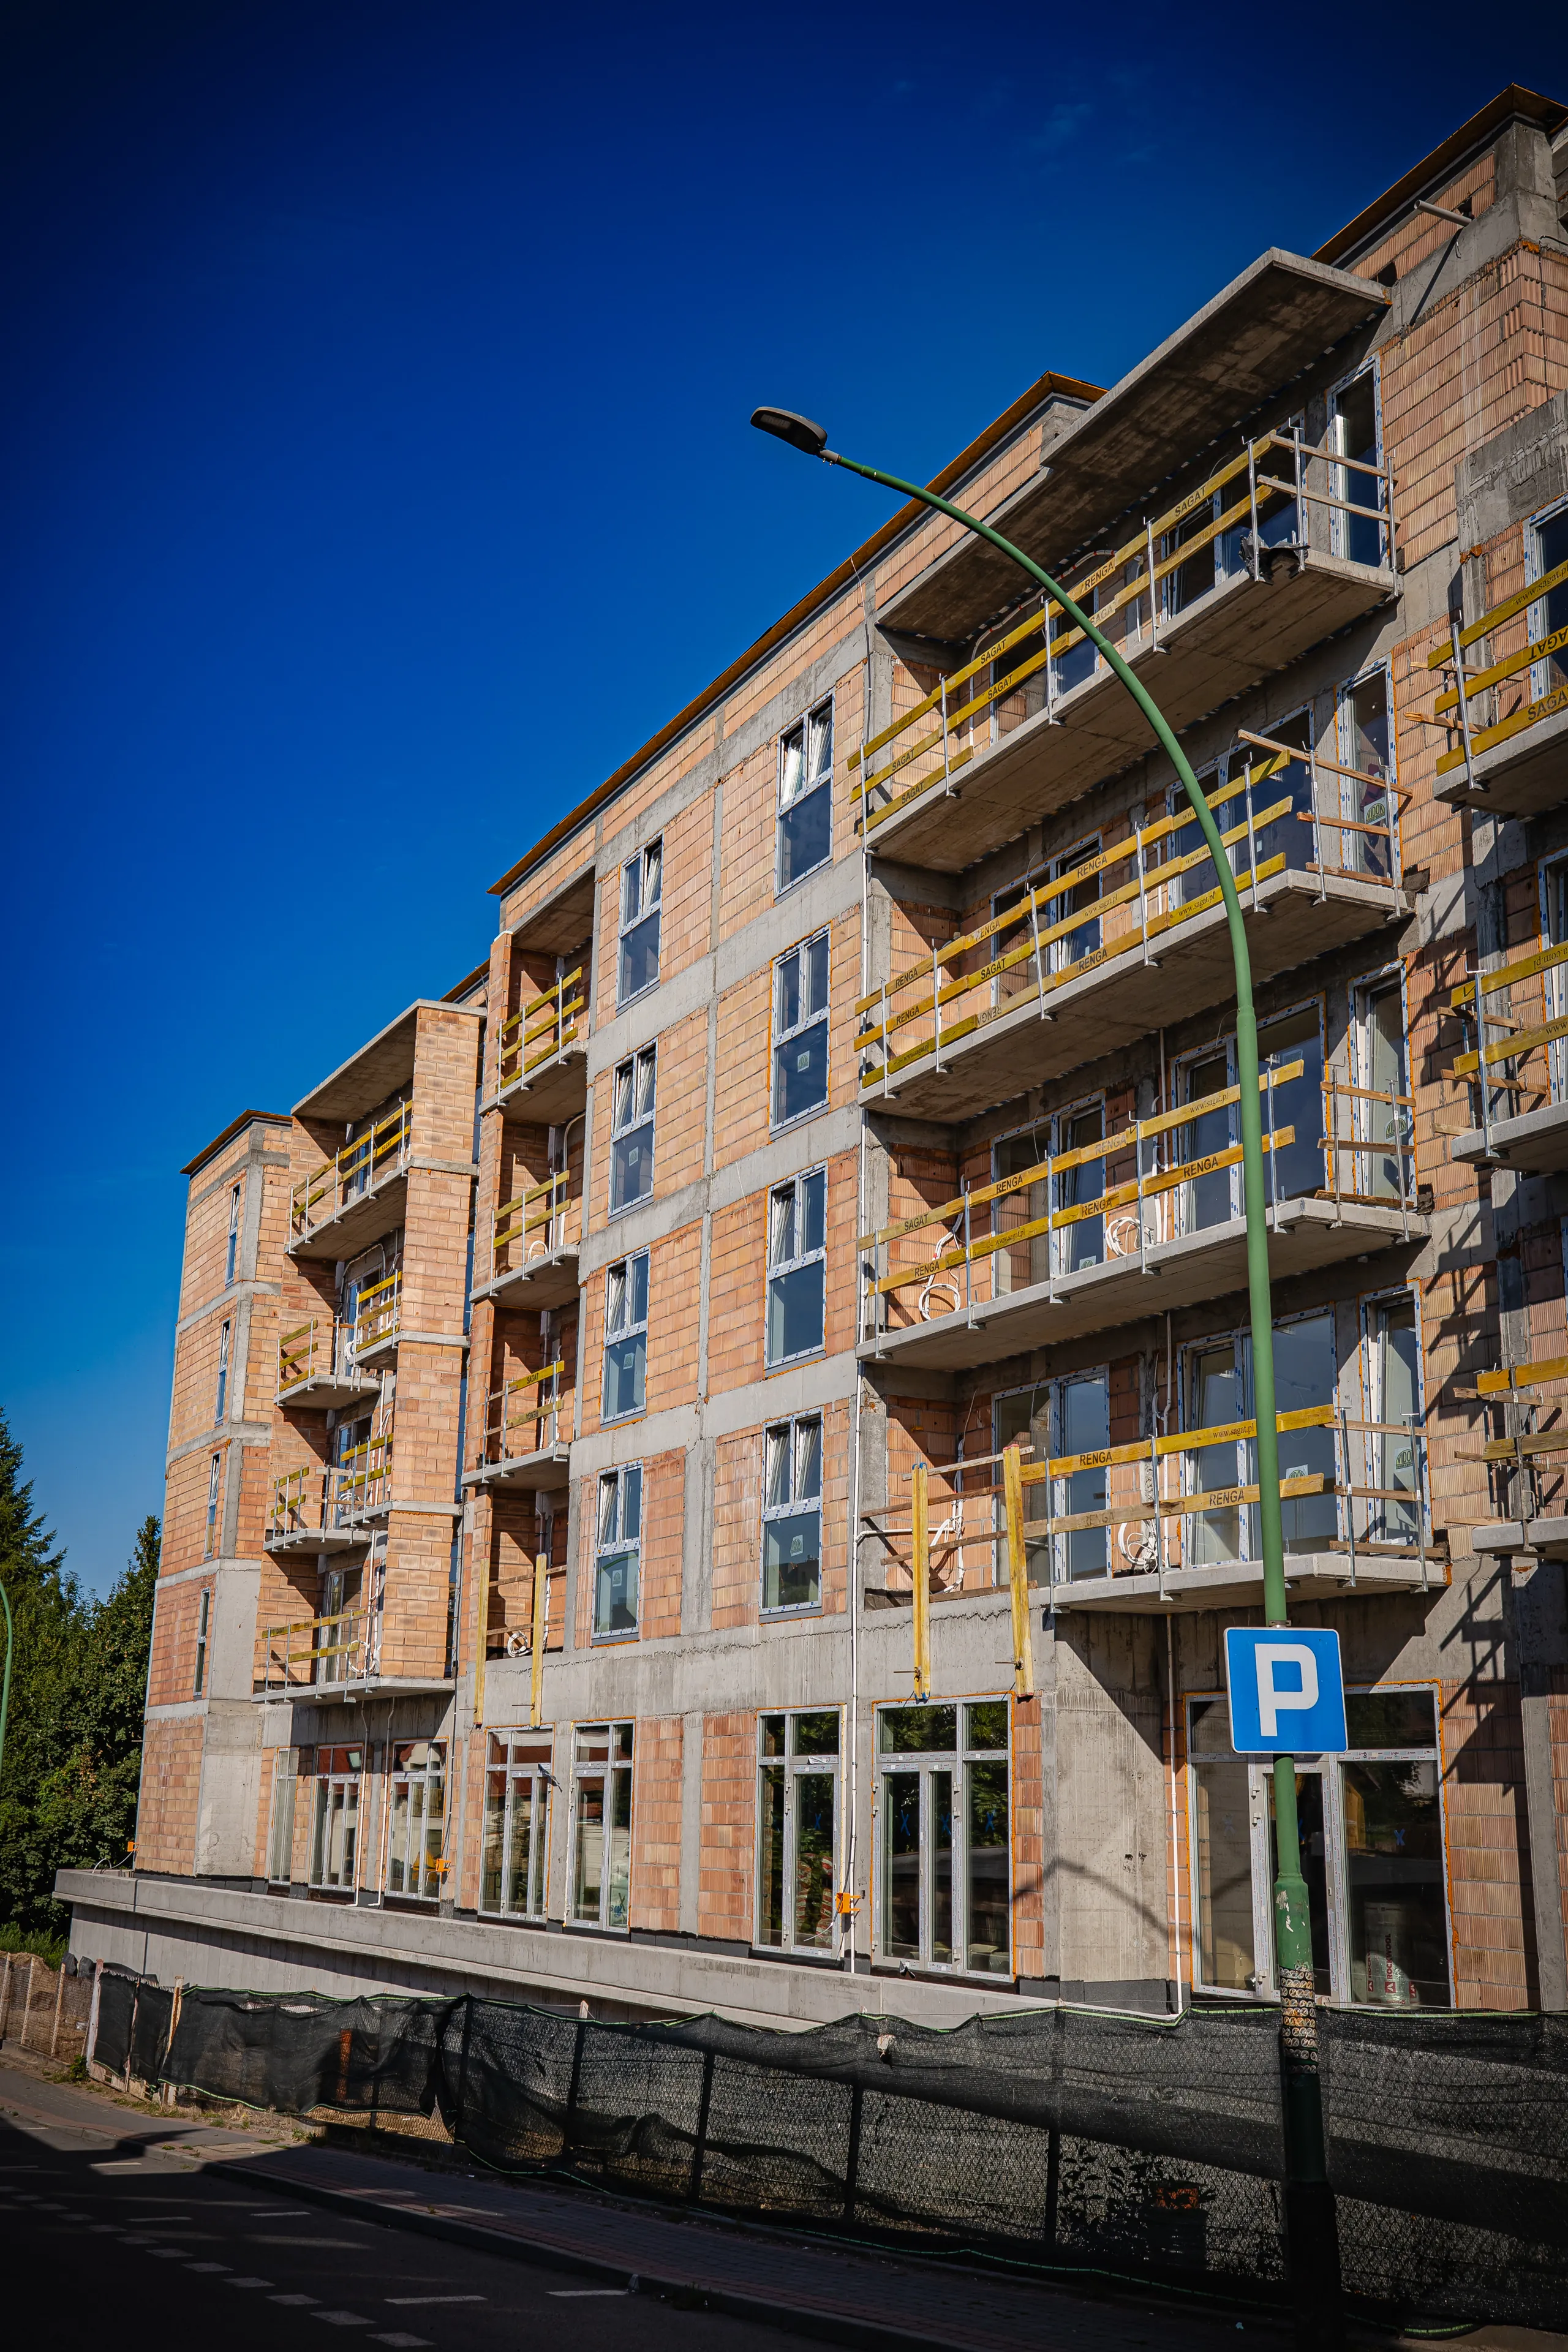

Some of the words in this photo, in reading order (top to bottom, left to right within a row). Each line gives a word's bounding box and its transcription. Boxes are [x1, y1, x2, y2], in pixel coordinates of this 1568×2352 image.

[1175, 485, 1206, 517] SAGAT
[1085, 562, 1114, 590] RENGA
[1090, 601, 1115, 625] SAGA
[981, 639, 1006, 665] SAGAT
[987, 674, 1013, 700] SAGAT
[1528, 687, 1568, 721] SAGA
[892, 748, 914, 771] SAGAT
[901, 781, 924, 804] SAGAT
[1367, 804, 1384, 819] VIDOK
[1077, 853, 1107, 879] RENGA
[1084, 894, 1118, 918] www.sagat.pl
[1178, 891, 1216, 917] www.sagat.pl
[981, 958, 1006, 980] SAGAT
[1079, 948, 1108, 972] RENGA
[1534, 947, 1568, 970] a.com.pl
[895, 968, 918, 989] RENGA
[896, 1005, 920, 1025] RENGA
[1189, 1093, 1228, 1114] www.sagat.pl
[1095, 1134, 1126, 1156] RENGA
[1183, 1156, 1218, 1178] RENGA
[996, 1175, 1023, 1194] RENGA
[1082, 1198, 1112, 1217] RENGA
[904, 1213, 929, 1231] SAGAT
[914, 1262, 940, 1277] RENGA
[527, 1373, 539, 1384] SAGAT
[1213, 1423, 1254, 1439] www.sagat.pl
[1080, 1451, 1112, 1466] RENGA
[1398, 1450, 1412, 1464] VIDO
[1209, 1489, 1244, 1506] RENGA
[1254, 1643, 1319, 1736] P
